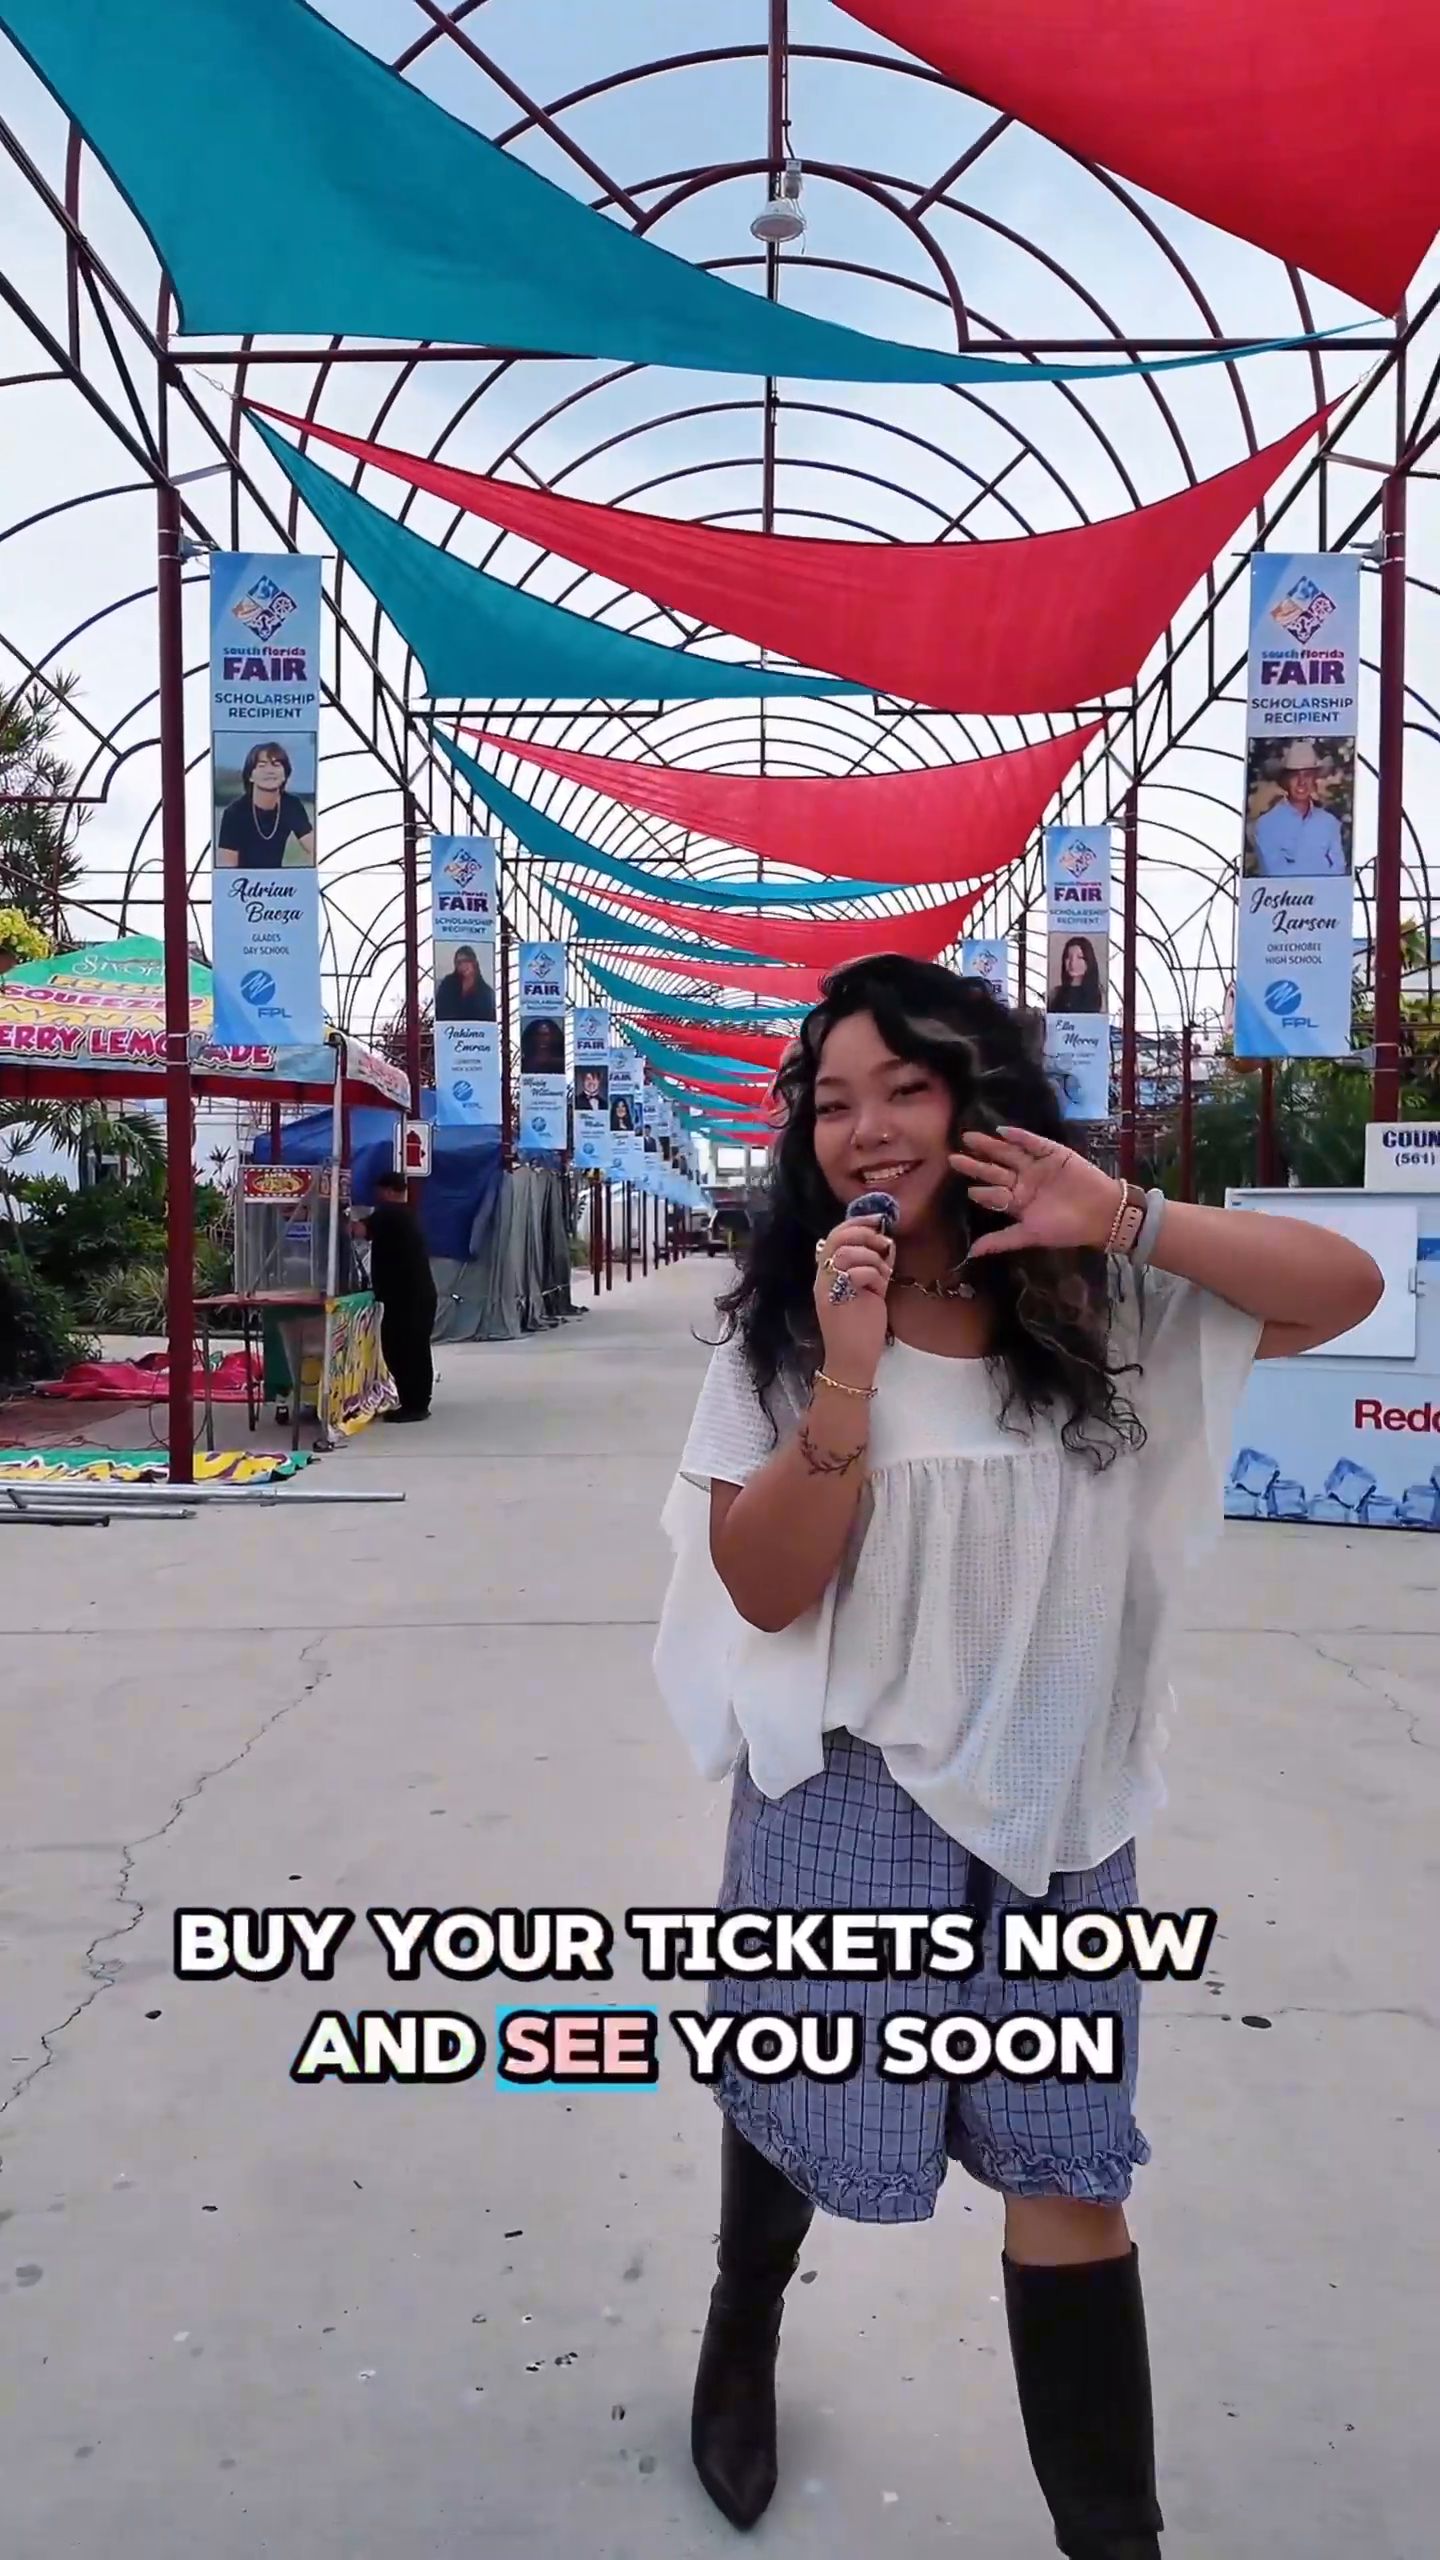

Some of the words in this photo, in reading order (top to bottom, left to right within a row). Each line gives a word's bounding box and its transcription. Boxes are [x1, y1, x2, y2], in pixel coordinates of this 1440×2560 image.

[223, 646, 261, 656] south
[262, 645, 306, 656] florida
[1261, 650, 1299, 659] south
[1300, 649, 1345, 659] florida
[223, 656, 308, 682] FAIR
[1261, 659, 1346, 686] FAIR
[214, 692, 316, 705] SCHOLARSHIP
[1251, 697, 1354, 710] SCHOLARSHIP
[228, 706, 303, 719] RECIPIENT
[1264, 711, 1340, 724] RECIPIENT
[228, 877, 297, 903] Adrian
[1054, 886, 1103, 902] FAIR
[438, 896, 489, 913] FAIR
[1250, 886, 1316, 914] Joshua
[1272, 909, 1341, 935] Larson
[251, 932, 282, 943] GLADES
[242, 946, 258, 956] DAY
[259, 946, 290, 956] SCHOOL
[1265, 955, 1288, 965] HIGH
[1288, 955, 1322, 965] SCHOOL
[524, 984, 561, 996] FAIR
[257, 1007, 292, 1019] FPL
[1281, 1016, 1320, 1029] FPL
[577, 1040, 605, 1051] FAIR
[1395, 1152, 1436, 1168] (561)
